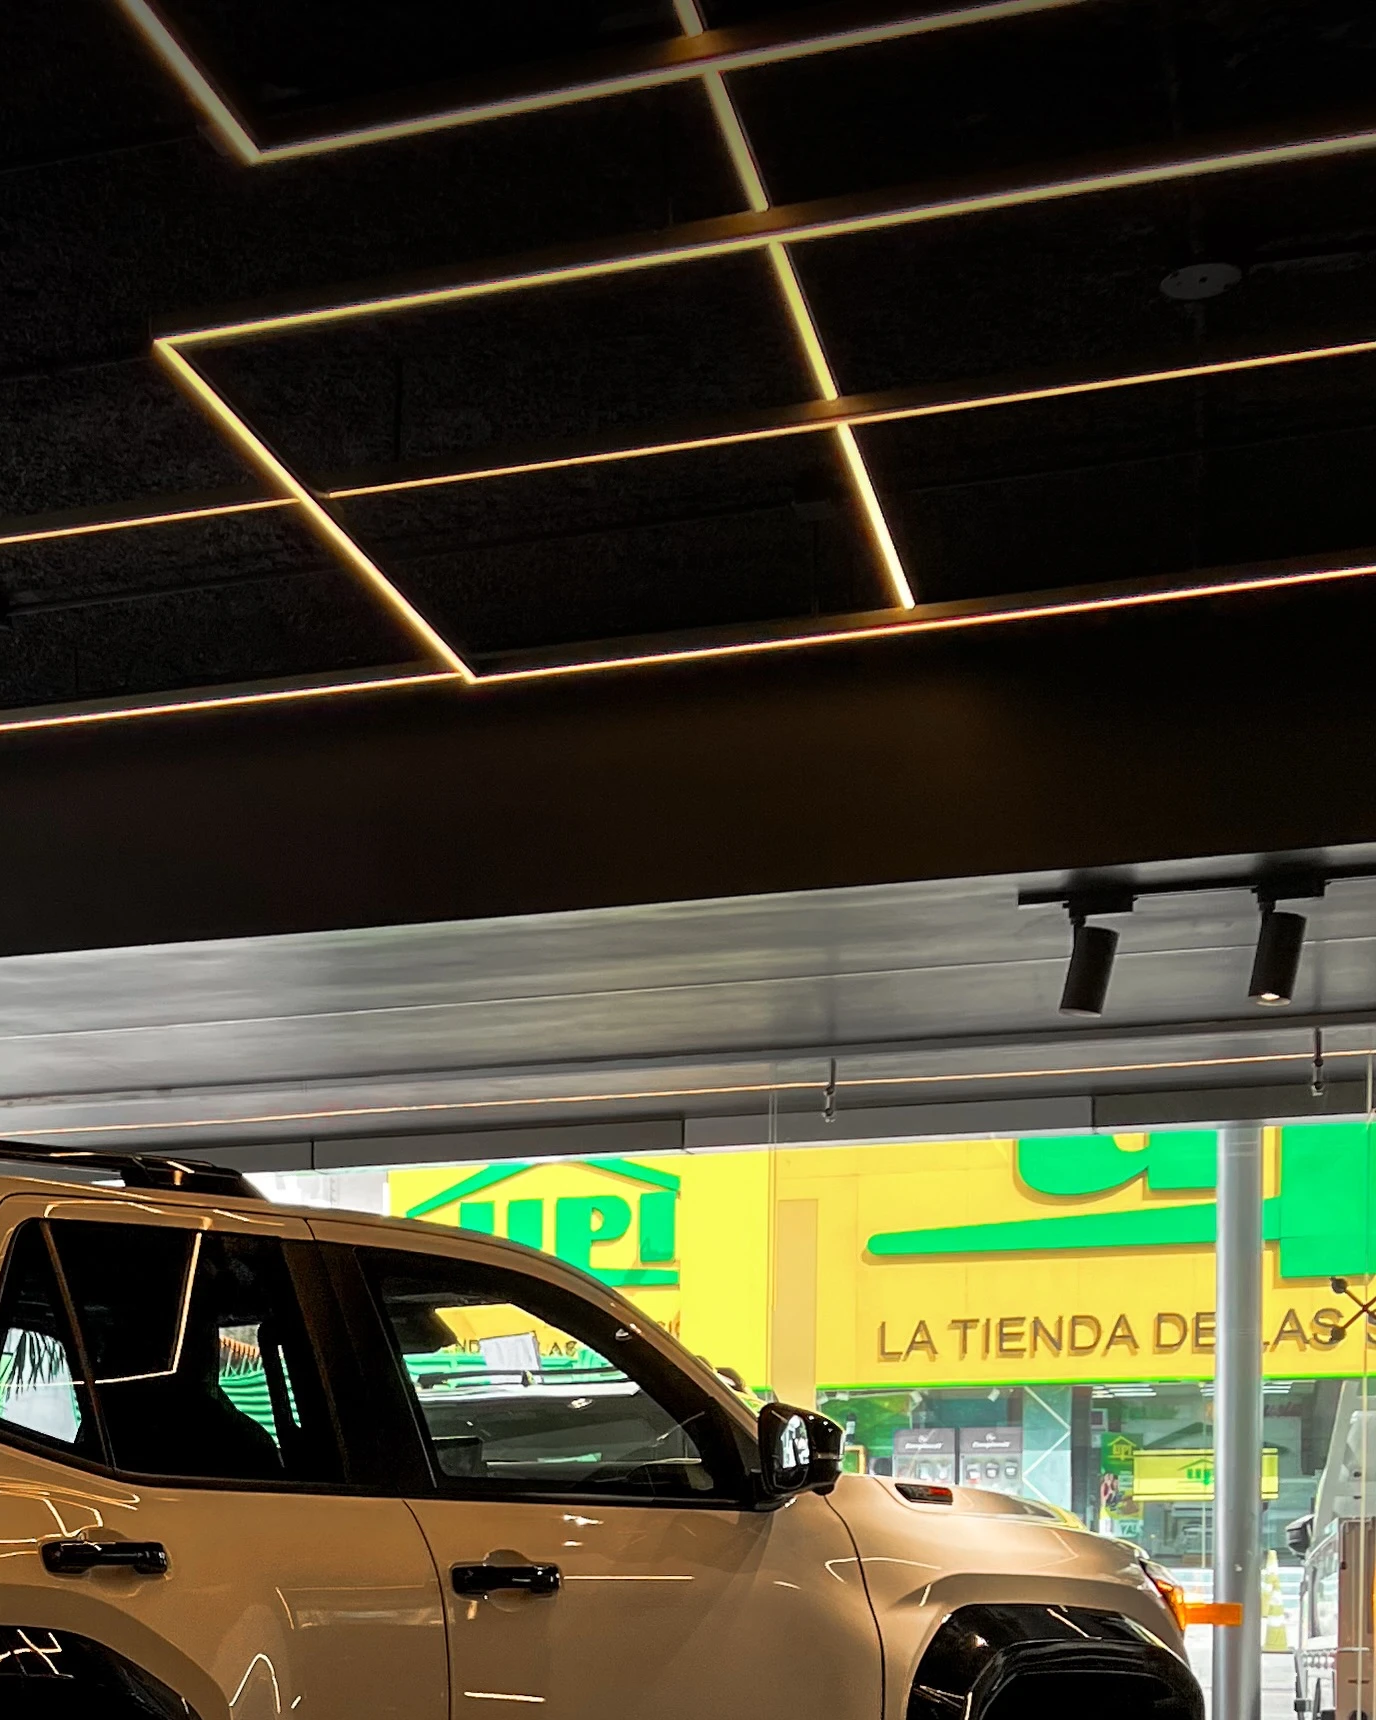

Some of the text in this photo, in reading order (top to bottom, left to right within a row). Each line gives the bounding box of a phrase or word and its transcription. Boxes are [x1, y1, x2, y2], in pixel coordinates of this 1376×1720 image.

[878, 1320, 938, 1361] LA
[948, 1314, 1139, 1360] TIENDA
[1262, 1308, 1345, 1352] AS
